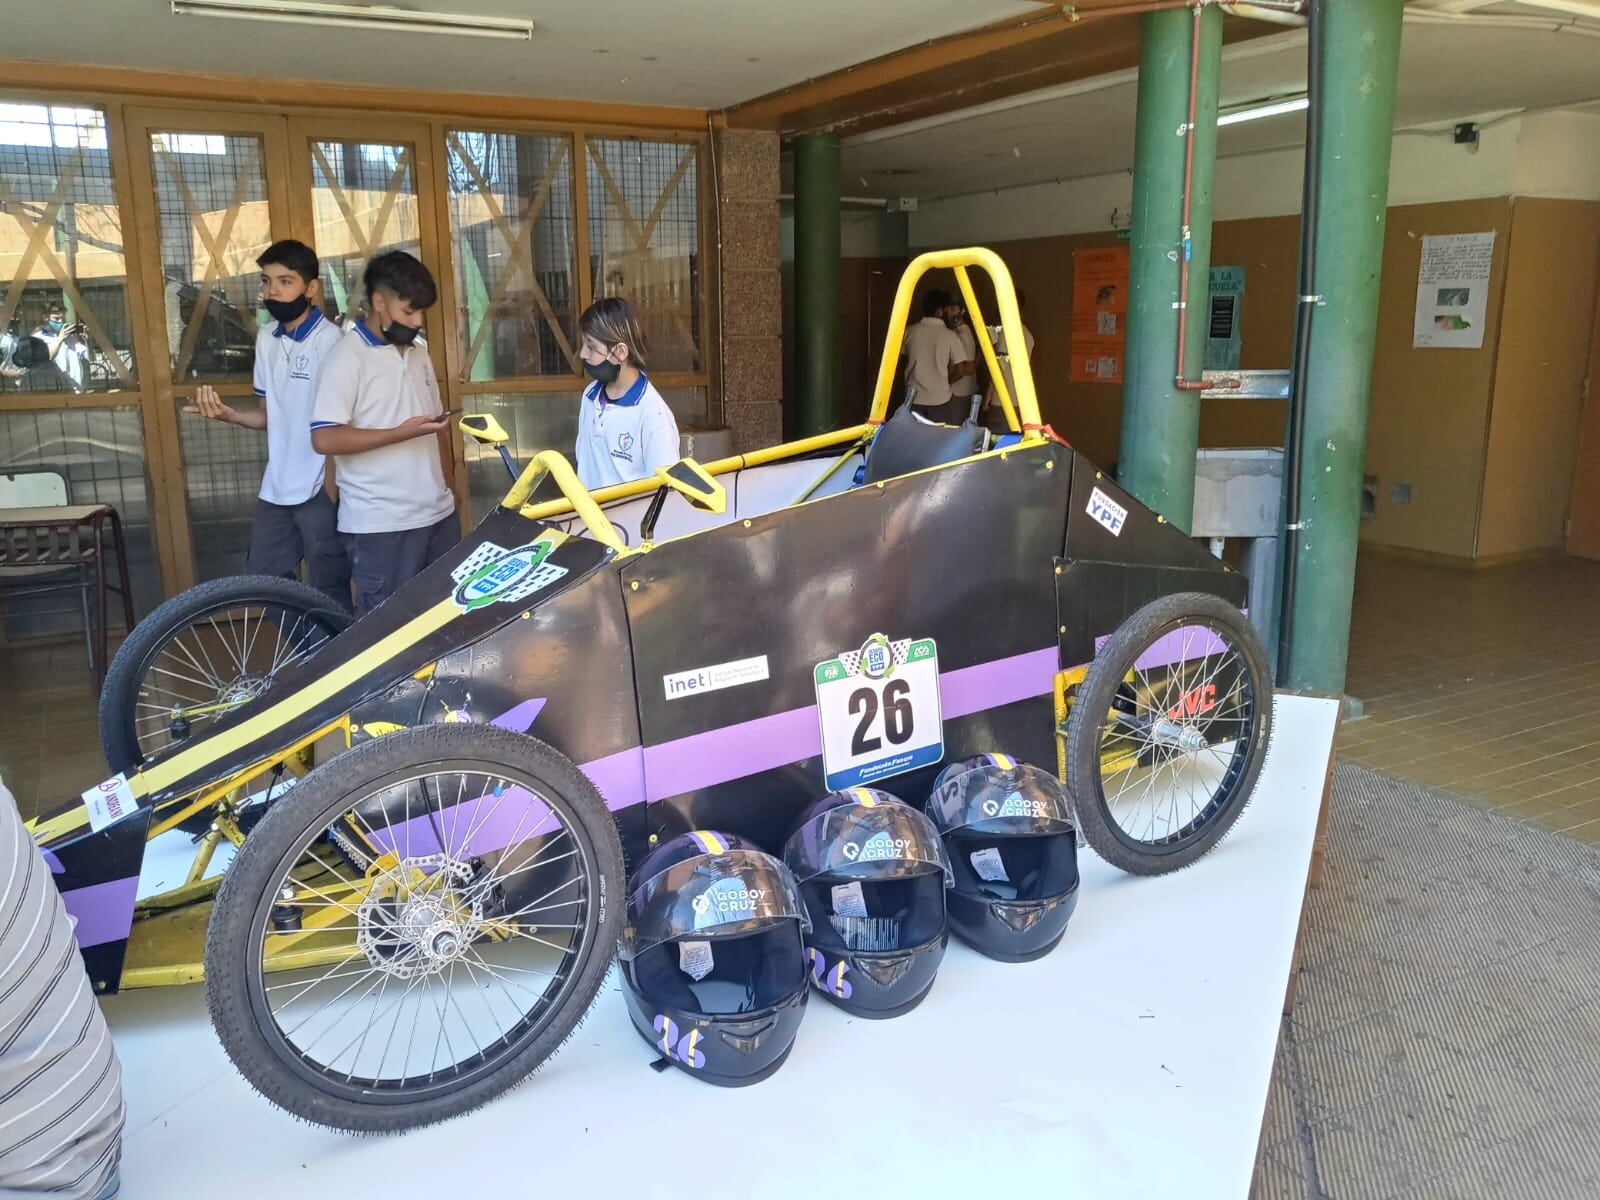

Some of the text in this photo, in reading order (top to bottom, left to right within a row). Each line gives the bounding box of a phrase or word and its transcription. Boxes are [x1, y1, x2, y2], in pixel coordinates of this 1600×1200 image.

[1092, 499, 1122, 530] YPF
[489, 564, 520, 582] ECO
[869, 652, 884, 664] ECO
[669, 673, 705, 693] inet
[1168, 683, 1216, 719] JVC
[848, 678, 914, 757] 26
[1005, 799, 1047, 809] GODOY
[1005, 808, 1039, 818] CRUZ
[865, 839, 911, 849] GODOY
[866, 848, 903, 858] CRUZ
[717, 889, 766, 901] GODOY
[719, 900, 757, 912] CRUZ
[654, 1014, 706, 1069] 26
